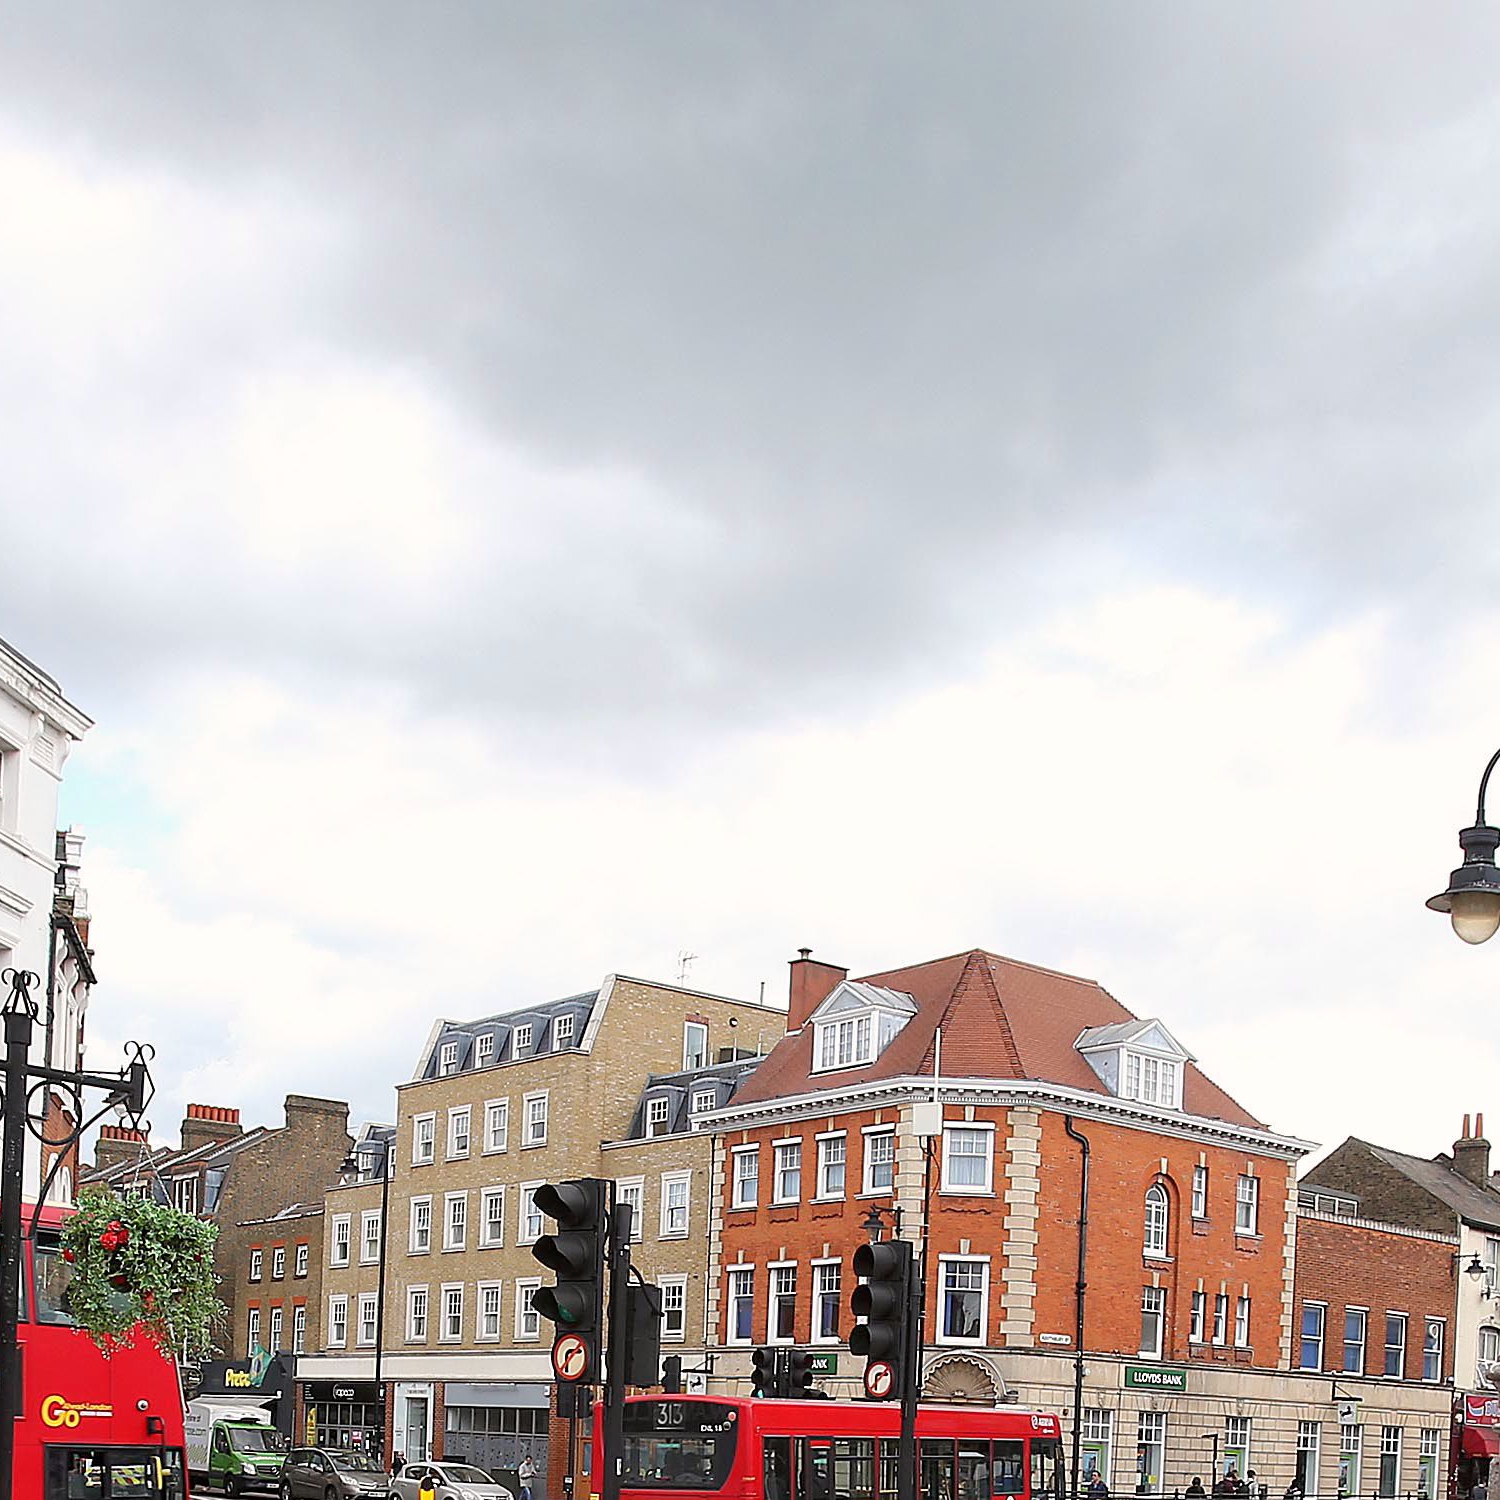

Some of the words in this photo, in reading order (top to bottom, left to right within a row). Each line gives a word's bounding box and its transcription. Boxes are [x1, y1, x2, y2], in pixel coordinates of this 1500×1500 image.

[1133, 1371, 1161, 1384] LLOYDS
[1162, 1374, 1183, 1386] BANK
[41, 1395, 80, 1428] Go
[657, 1403, 684, 1425] 313
